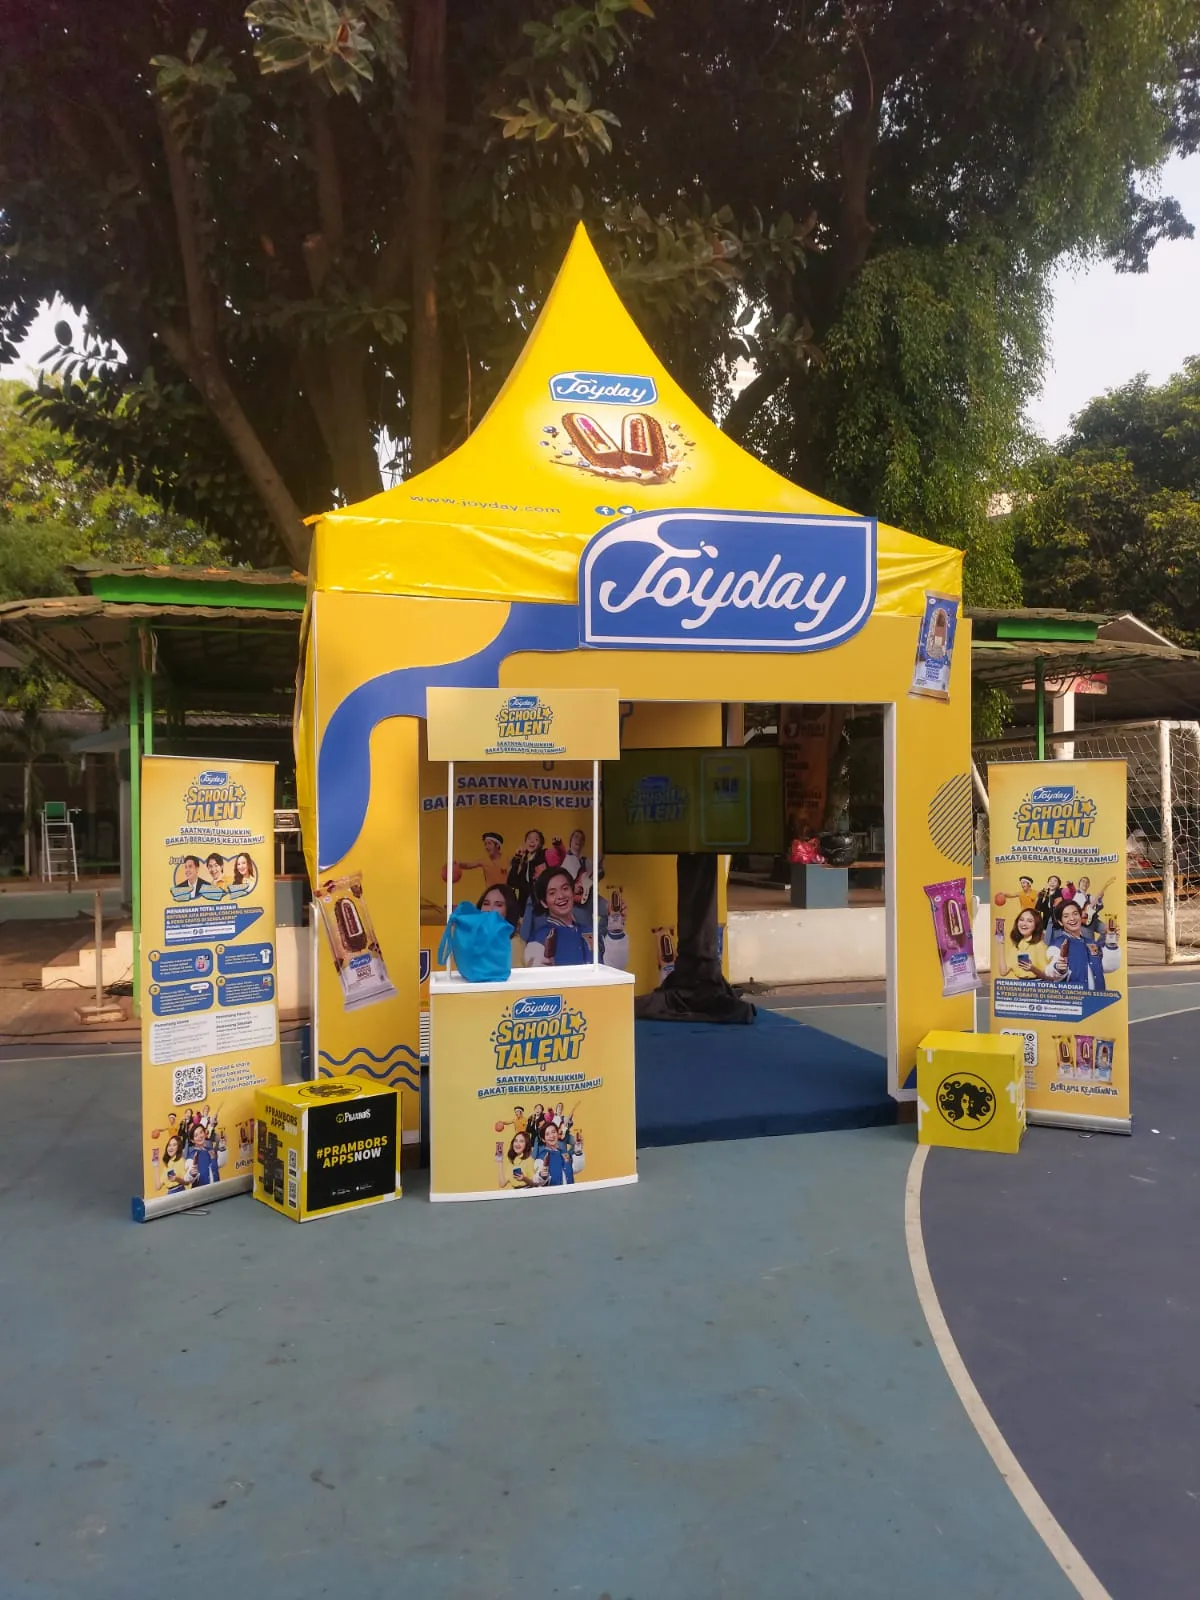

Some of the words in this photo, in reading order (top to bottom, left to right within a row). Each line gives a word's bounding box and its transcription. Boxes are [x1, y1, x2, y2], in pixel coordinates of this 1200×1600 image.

[557, 380, 647, 400] Joyday
[410, 496, 561, 514] www.joyday.com
[598, 542, 846, 632] Joyday
[499, 707, 543, 721] SCHOOL
[498, 719, 552, 737] TALENT
[457, 776, 528, 789] SAATNYA
[531, 778, 595, 792] TUNJUK
[187, 785, 236, 803] SCHOOL
[479, 793, 552, 807] BERLAPIS
[555, 796, 595, 809] KEJU
[1034, 789, 1070, 802] Joyday
[186, 801, 245, 823] TALENT
[1018, 800, 1084, 821] SCHOOL
[212, 828, 250, 836] TUNJUKKIN
[1016, 818, 1095, 842] TALENT
[165, 836, 187, 844] BAKAT
[995, 854, 1020, 863] BAKAT
[1022, 854, 1062, 862] BERLAPIS
[1063, 854, 1117, 864] KEJUTANMU!
[515, 1001, 558, 1016] Joyday
[497, 1012, 571, 1044] SCHOOL
[494, 1033, 585, 1070] TALENT
[496, 1076, 536, 1084] SAATNYA
[537, 1073, 584, 1082] TUNJUKKIN
[478, 1086, 506, 1098] BAKAT
[508, 1084, 548, 1094] BERLAPIS
[550, 1079, 602, 1092] KEJUTANMU!
[316, 1136, 388, 1159] #PRAMBORS
[322, 1148, 382, 1168] APPSNOW
